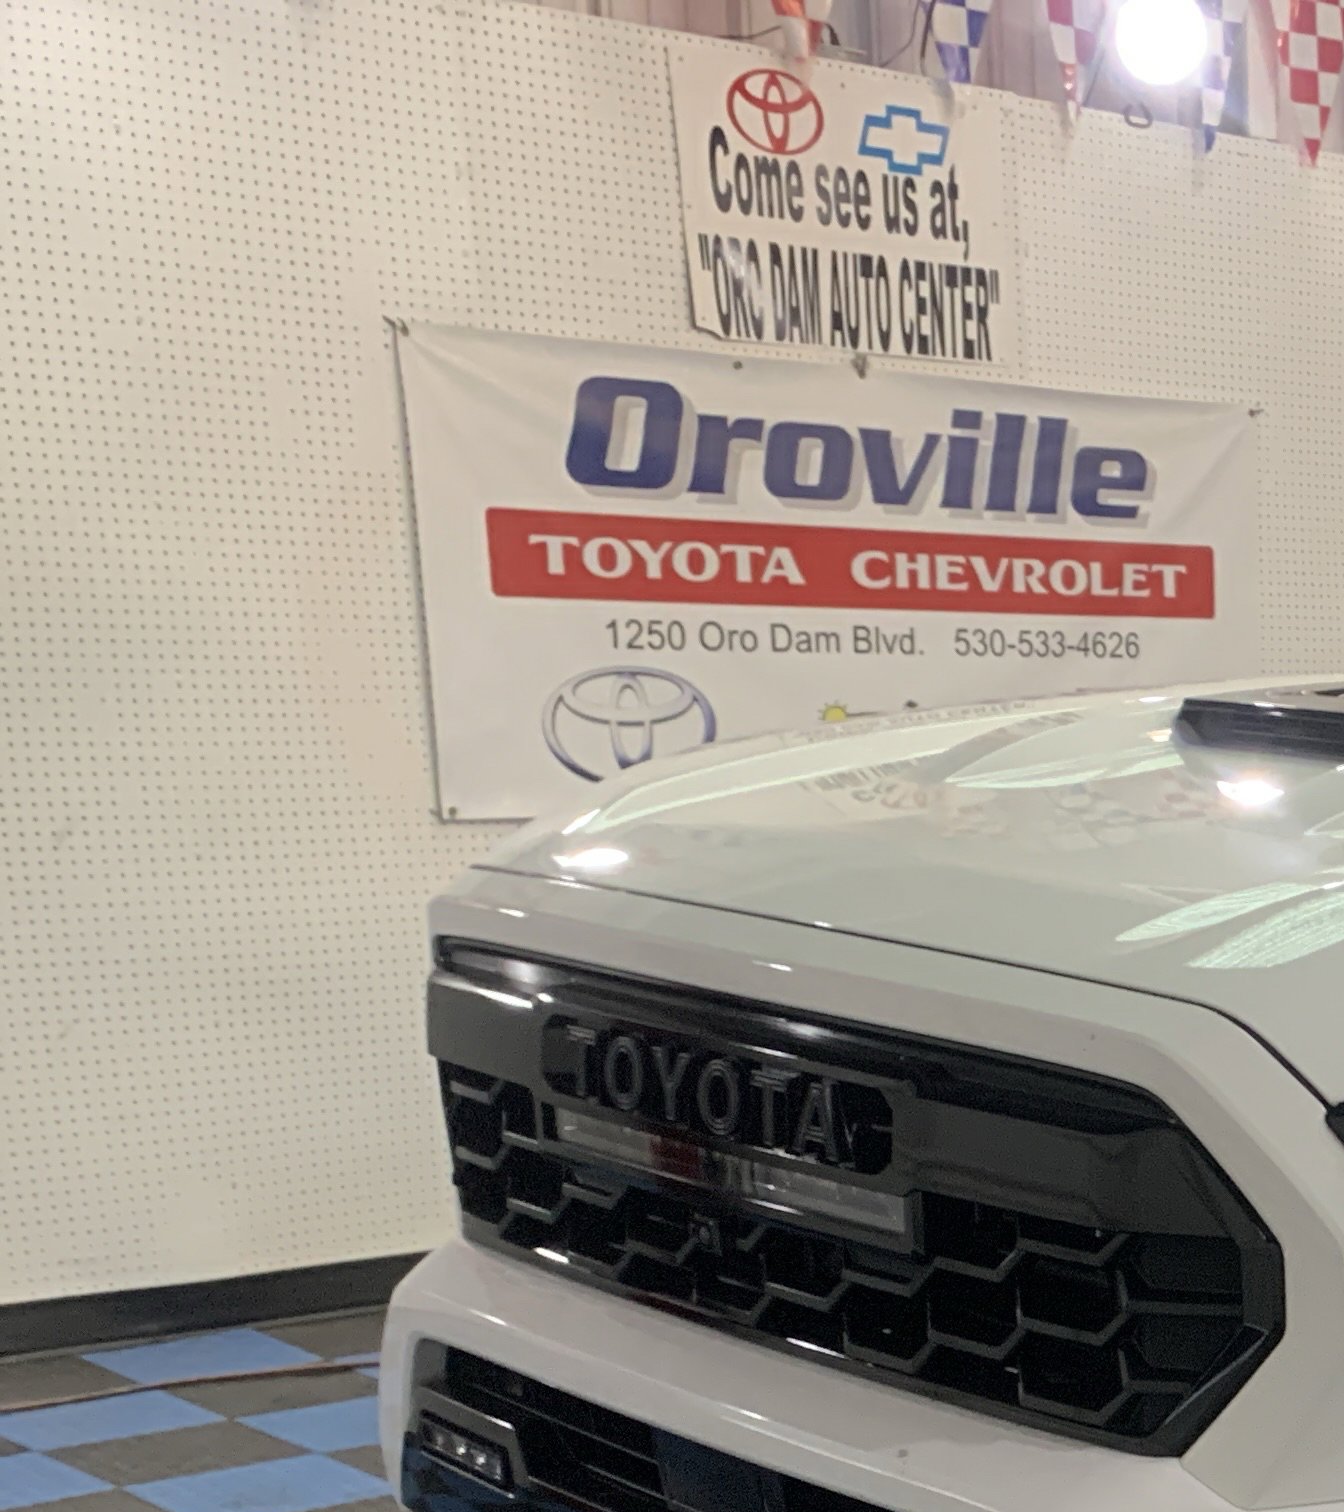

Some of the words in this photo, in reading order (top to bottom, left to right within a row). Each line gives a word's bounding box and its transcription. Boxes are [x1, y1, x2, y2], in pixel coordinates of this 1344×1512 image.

[709, 125, 805, 223] Come
[815, 163, 872, 231] see
[882, 173, 920, 237] us
[929, 163, 970, 261] at,
[769, 241, 823, 345] DAM
[829, 249, 892, 353] AUTO
[899, 256, 1000, 362] CENTER"
[565, 375, 1150, 520] Oroville
[527, 533, 807, 586] TOYOTA
[850, 549, 1188, 599] CHEVROLET
[605, 619, 687, 650] 1250
[699, 620, 759, 653] Oro
[769, 622, 841, 653] Dam
[852, 624, 925, 656] Blvd.
[954, 628, 1141, 659] 530-533-4626
[565, 1023, 857, 1169] TOYOTA
